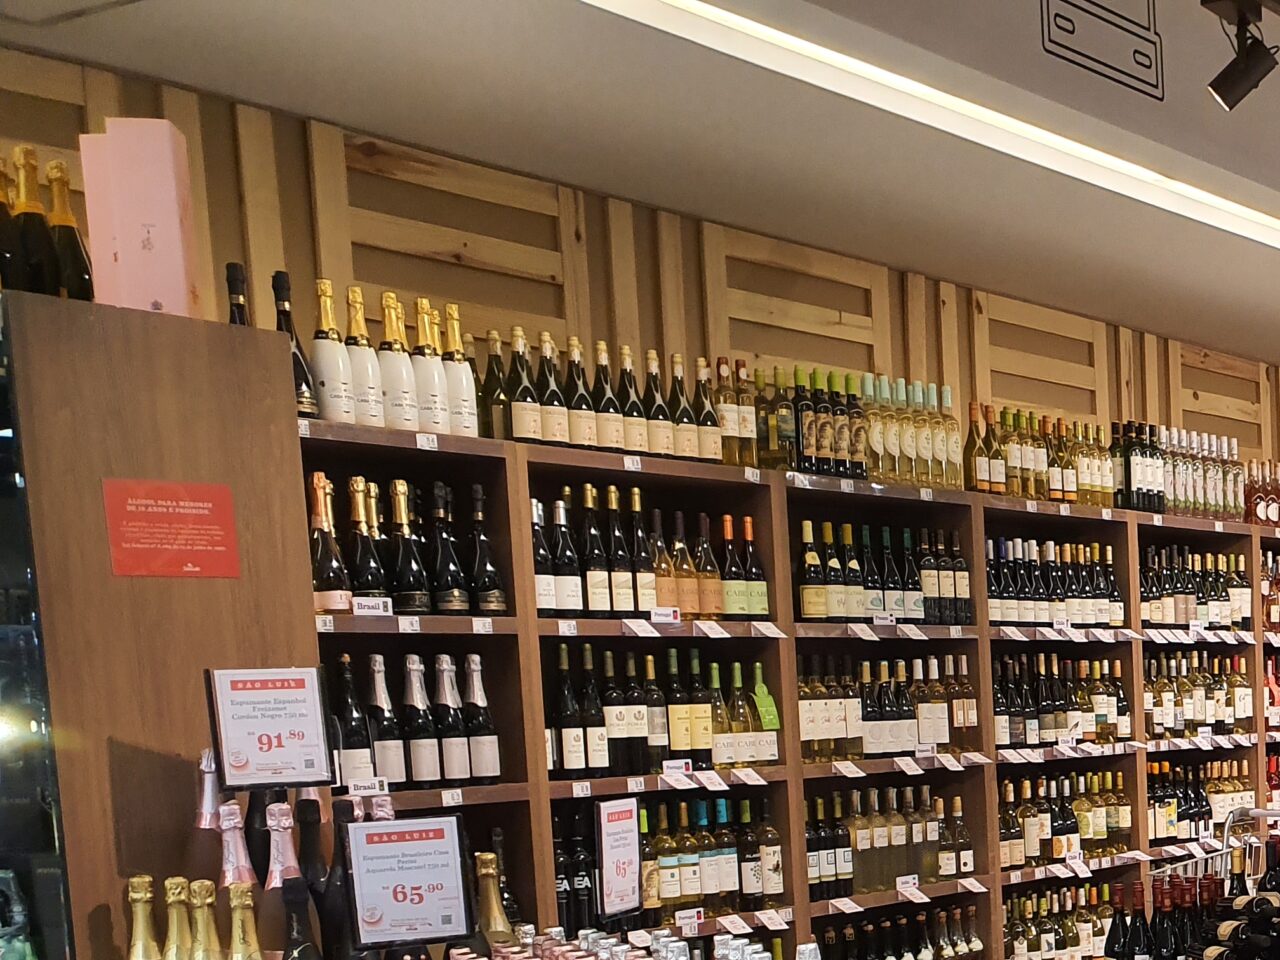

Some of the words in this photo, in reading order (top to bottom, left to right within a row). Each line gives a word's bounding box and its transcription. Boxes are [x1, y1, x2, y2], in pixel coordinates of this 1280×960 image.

[356, 600, 381, 611] Brasil
[352, 782, 377, 792] Brasil
[574, 876, 592, 889] EA
